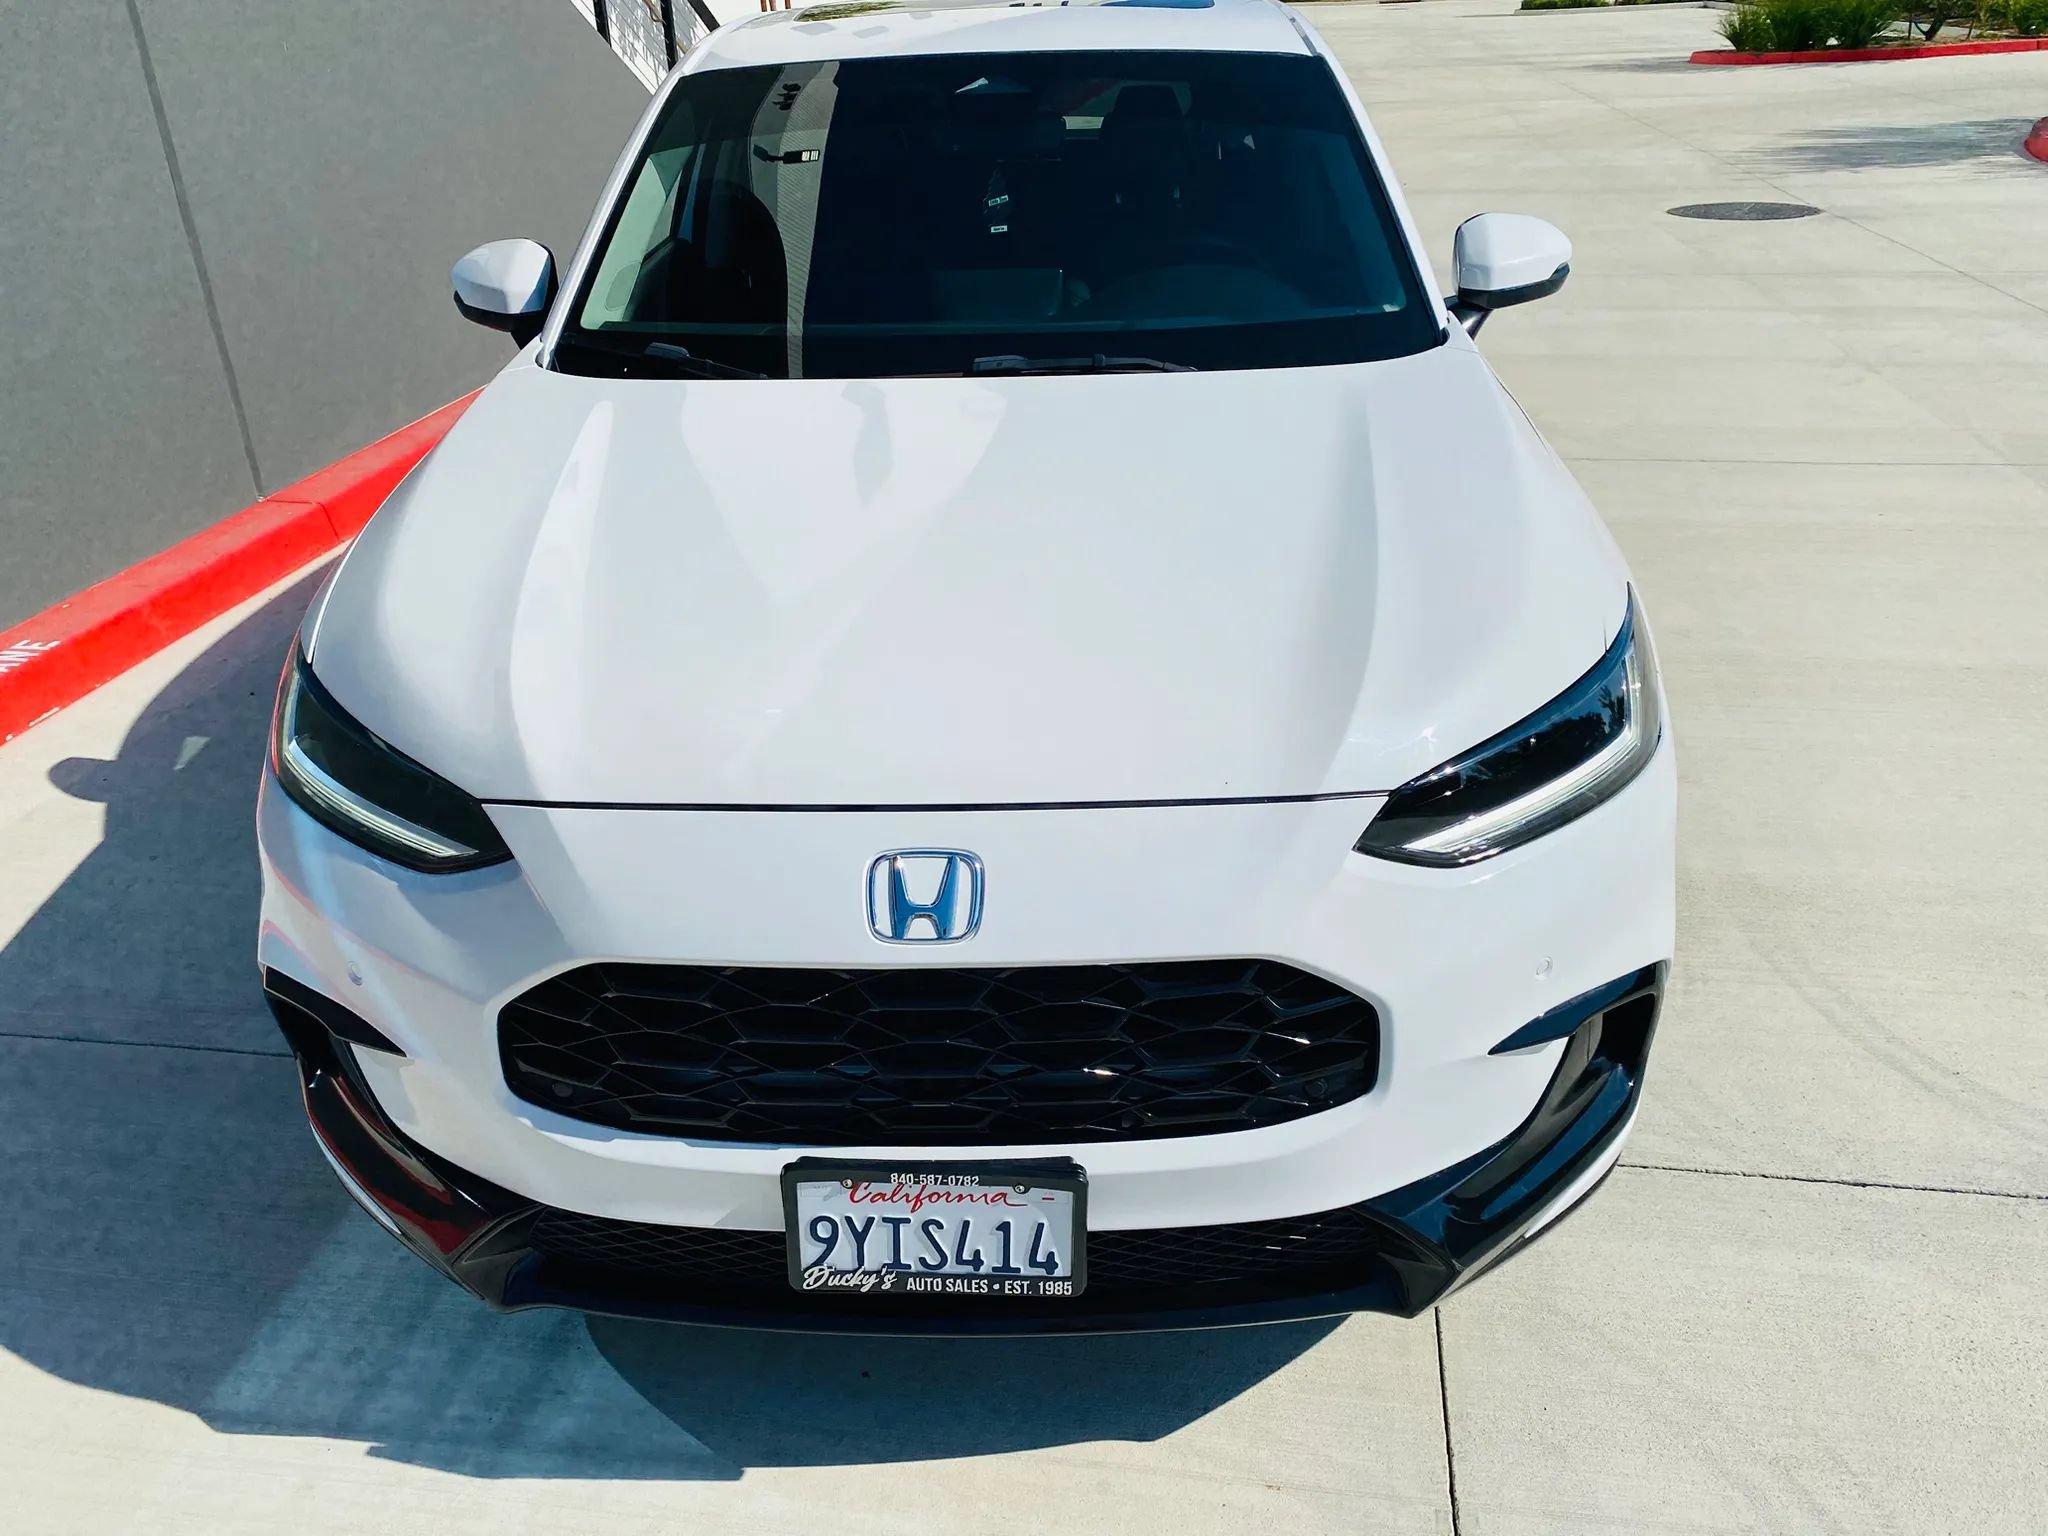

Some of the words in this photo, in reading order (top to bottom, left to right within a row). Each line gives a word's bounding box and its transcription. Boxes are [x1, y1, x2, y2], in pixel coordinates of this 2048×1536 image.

[890, 1172, 980, 1187] 840-587-0782
[849, 1182, 1028, 1213] California
[803, 1215, 1059, 1276] 9YIS414
[906, 1277, 943, 1291] AUTO
[945, 1278, 988, 1293] SALES
[1004, 1280, 1032, 1294] EST.
[1038, 1281, 1073, 1295] 1985
